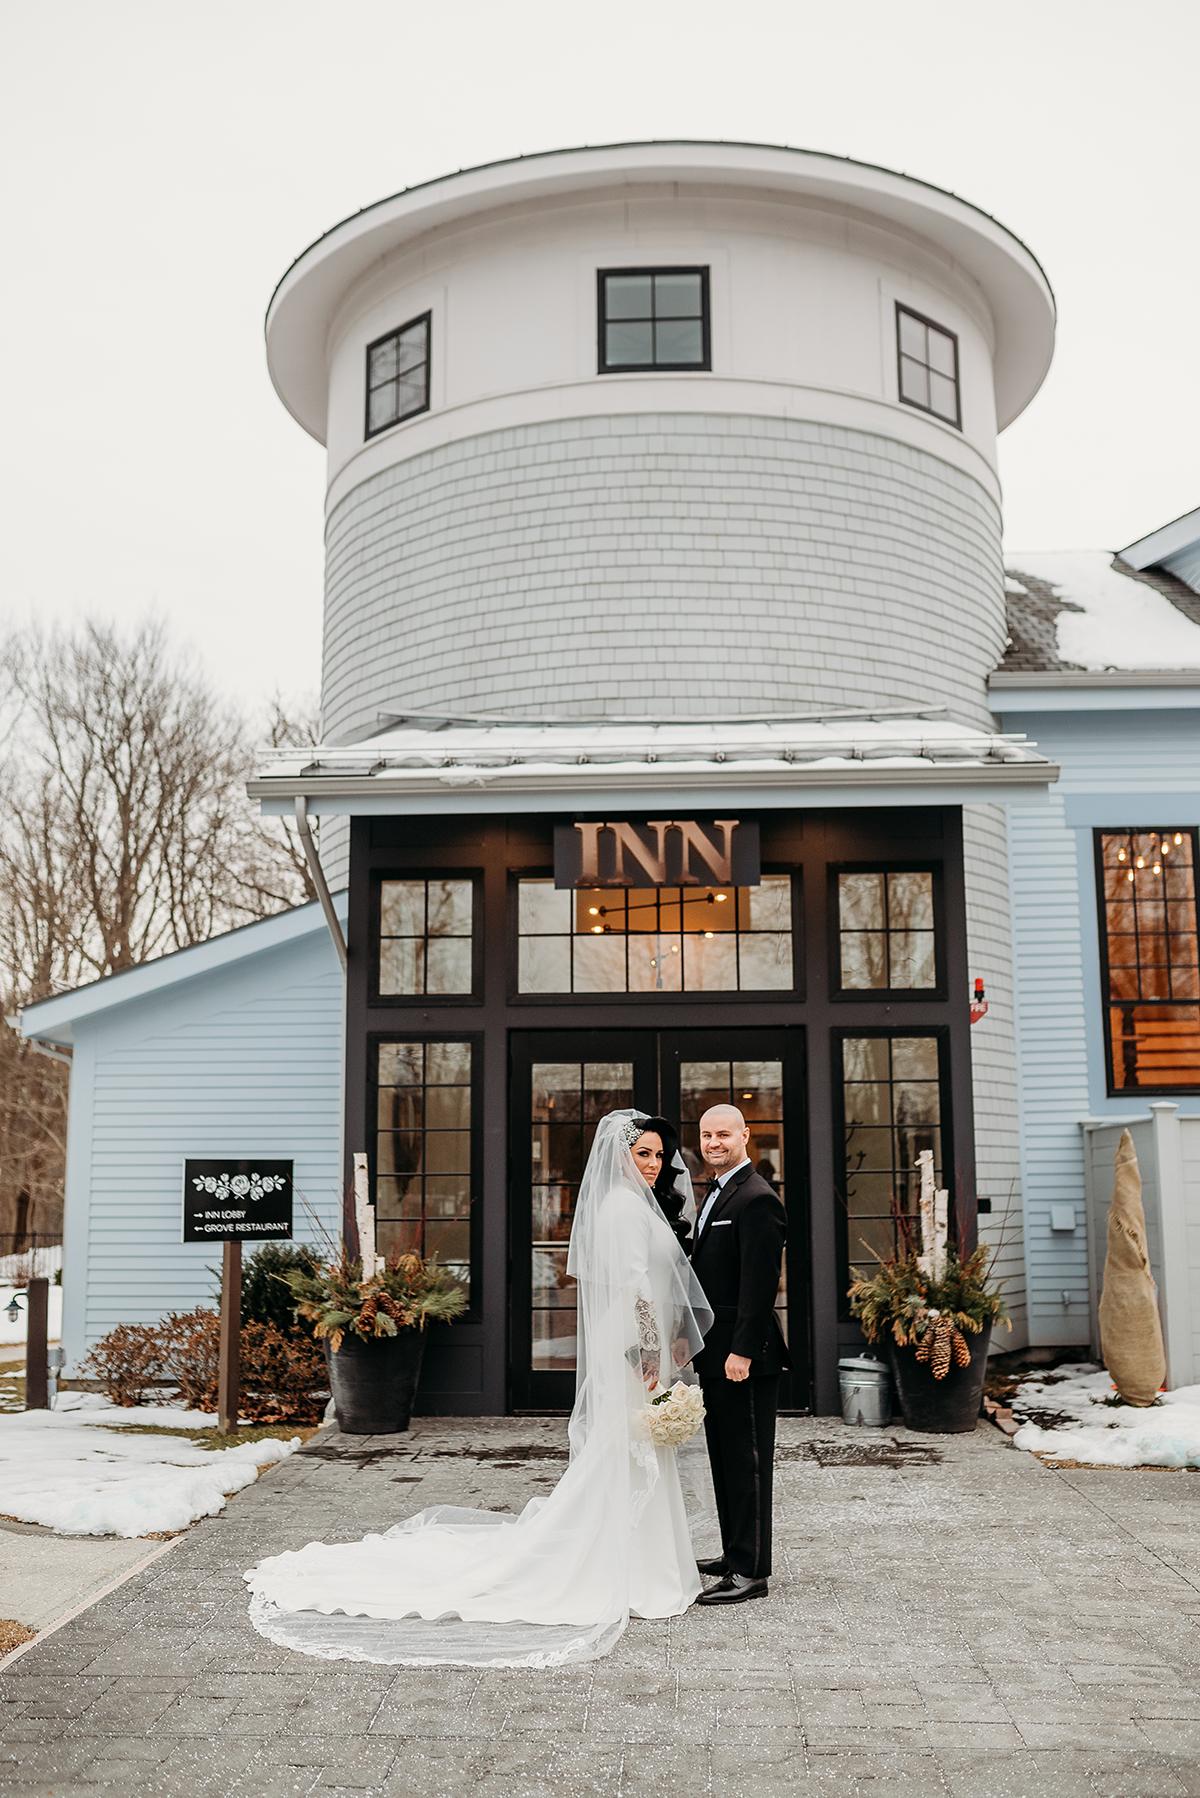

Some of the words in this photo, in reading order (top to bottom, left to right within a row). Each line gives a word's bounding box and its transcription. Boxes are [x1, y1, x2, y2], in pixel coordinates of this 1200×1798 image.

[573, 820, 740, 885] INN
[205, 1211, 220, 1219] INN
[221, 1211, 246, 1219] LOBBY
[204, 1223, 234, 1232] GROVE
[235, 1222, 289, 1231] RESTAURANT
